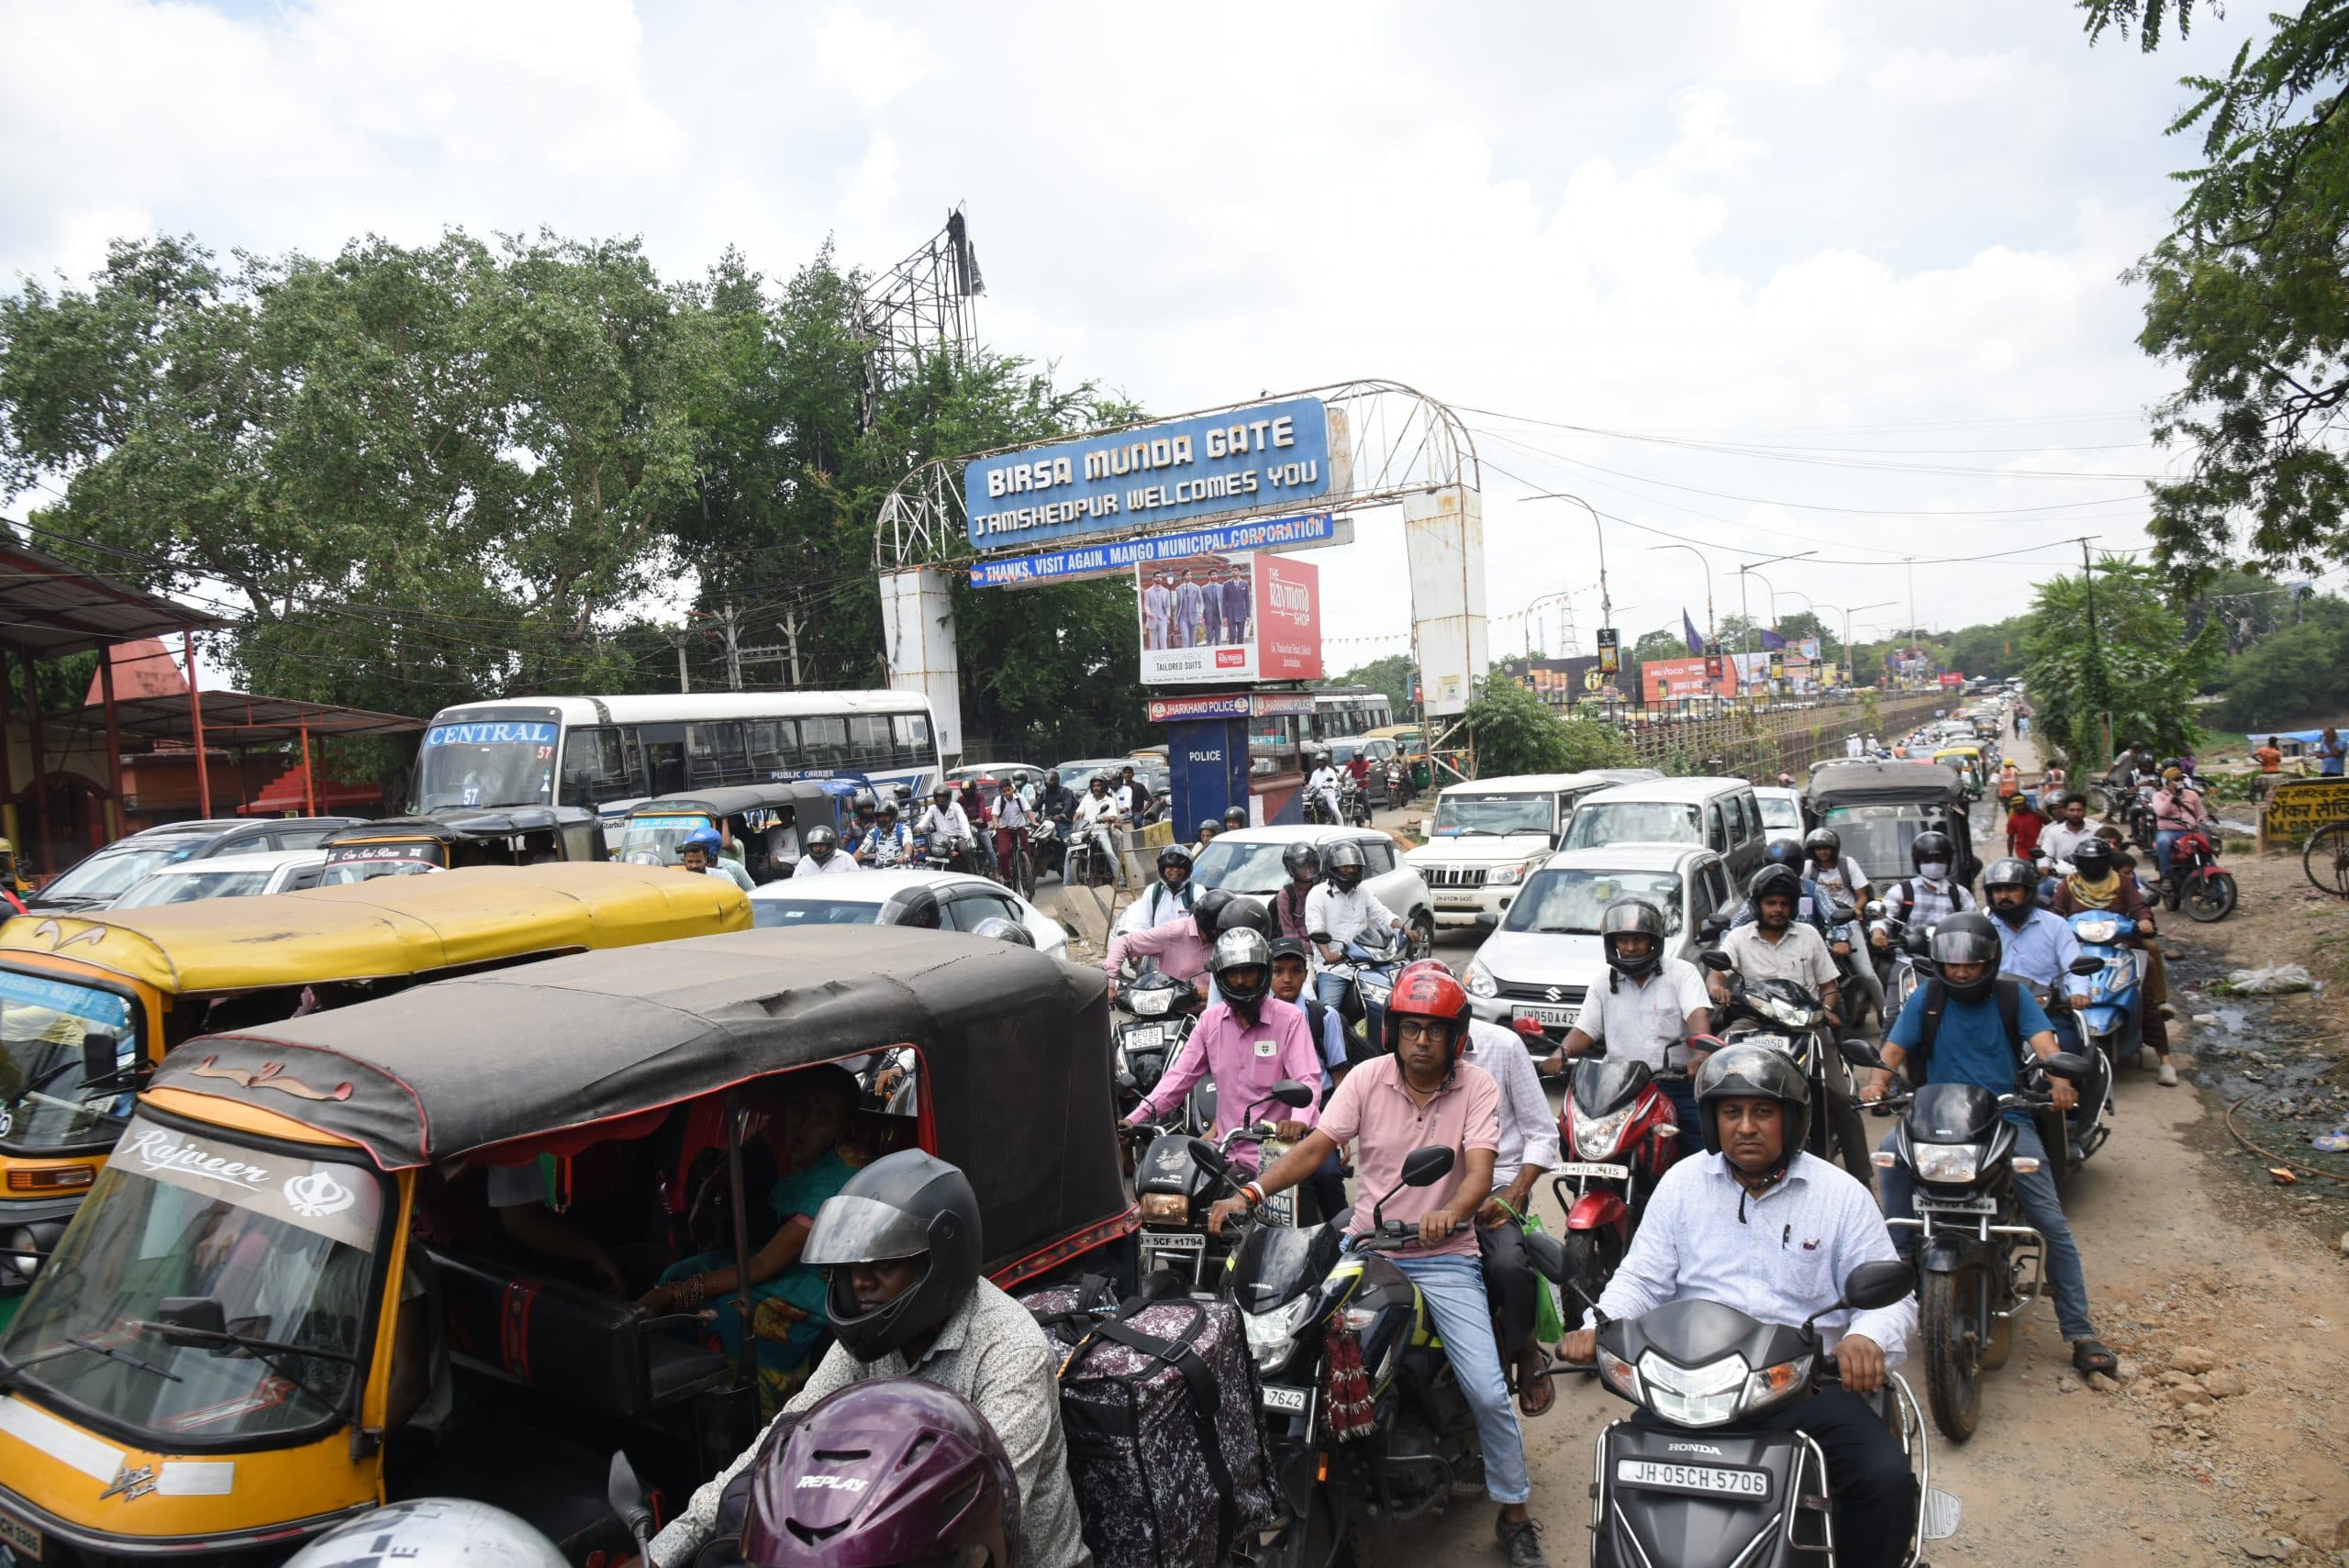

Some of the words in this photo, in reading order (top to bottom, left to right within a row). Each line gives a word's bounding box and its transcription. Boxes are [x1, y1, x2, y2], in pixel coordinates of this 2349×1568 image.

[987, 457, 1073, 498] BIRSA
[1085, 434, 1194, 481] MUNDA
[1206, 416, 1295, 459] GATE
[974, 494, 1119, 536] JAMSHEDPUR
[1127, 470, 1258, 511] WELCOMES
[1268, 459, 1318, 487] YOU
[1035, 556, 1064, 575] VISIT
[1068, 550, 1108, 571] AGAIN.
[1110, 542, 1154, 564] MANGO
[1158, 534, 1228, 558] MUNICIPAL
[1230, 518, 1325, 547] CORPORATION
[1294, 613, 1309, 627] SHOP
[1156, 662, 1183, 672] TAILORED
[1185, 661, 1202, 671] SUITS
[1166, 702, 1208, 716] JHARKHAND
[1209, 700, 1234, 712] POLICE
[1264, 699, 1293, 712] JHARKHAND
[1294, 698, 1310, 710] POLICE
[429, 724, 550, 745] CENTRAL
[537, 746, 552, 759] 57
[1189, 750, 1221, 762] POLICE
[771, 770, 801, 779] PUBLIC
[805, 769, 834, 778] CARRIER
[463, 787, 479, 805] 57
[121, 1129, 271, 1184] Rajveer
[1269, 1390, 1302, 1407] 7642
[1668, 1442, 1722, 1455] HONDA
[796, 1474, 869, 1492] REPLAY
